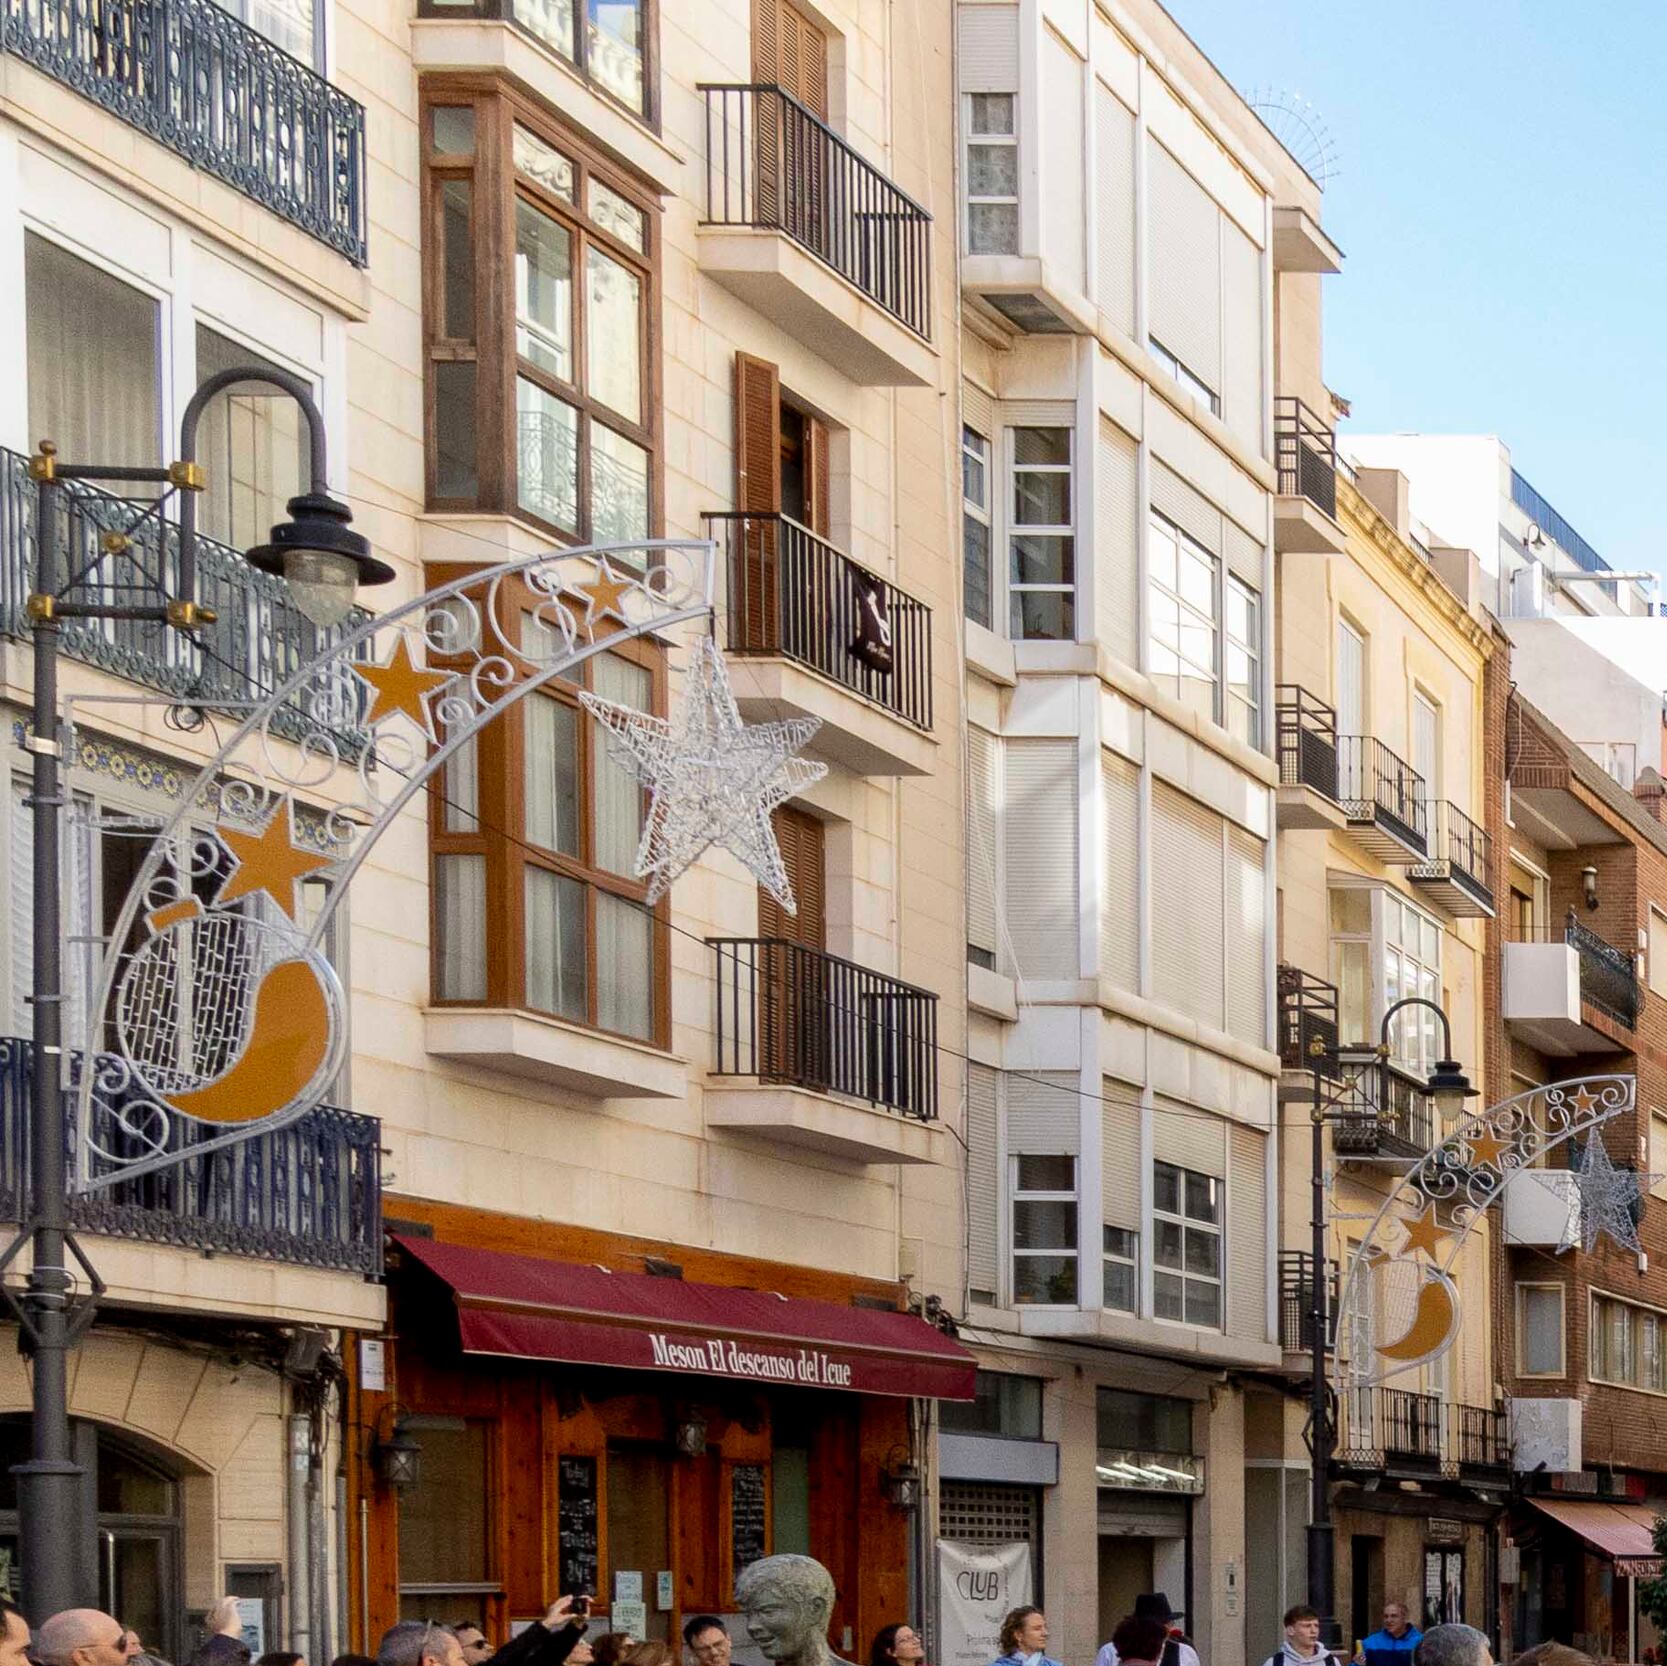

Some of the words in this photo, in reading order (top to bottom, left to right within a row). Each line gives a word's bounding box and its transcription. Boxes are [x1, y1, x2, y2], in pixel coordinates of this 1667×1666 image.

[648, 1333, 709, 1371] Meson
[706, 1338, 728, 1373] El
[728, 1340, 796, 1380] descanso
[798, 1349, 820, 1383] del
[821, 1353, 851, 1386] Icue
[956, 1570, 999, 1602] CLUB
